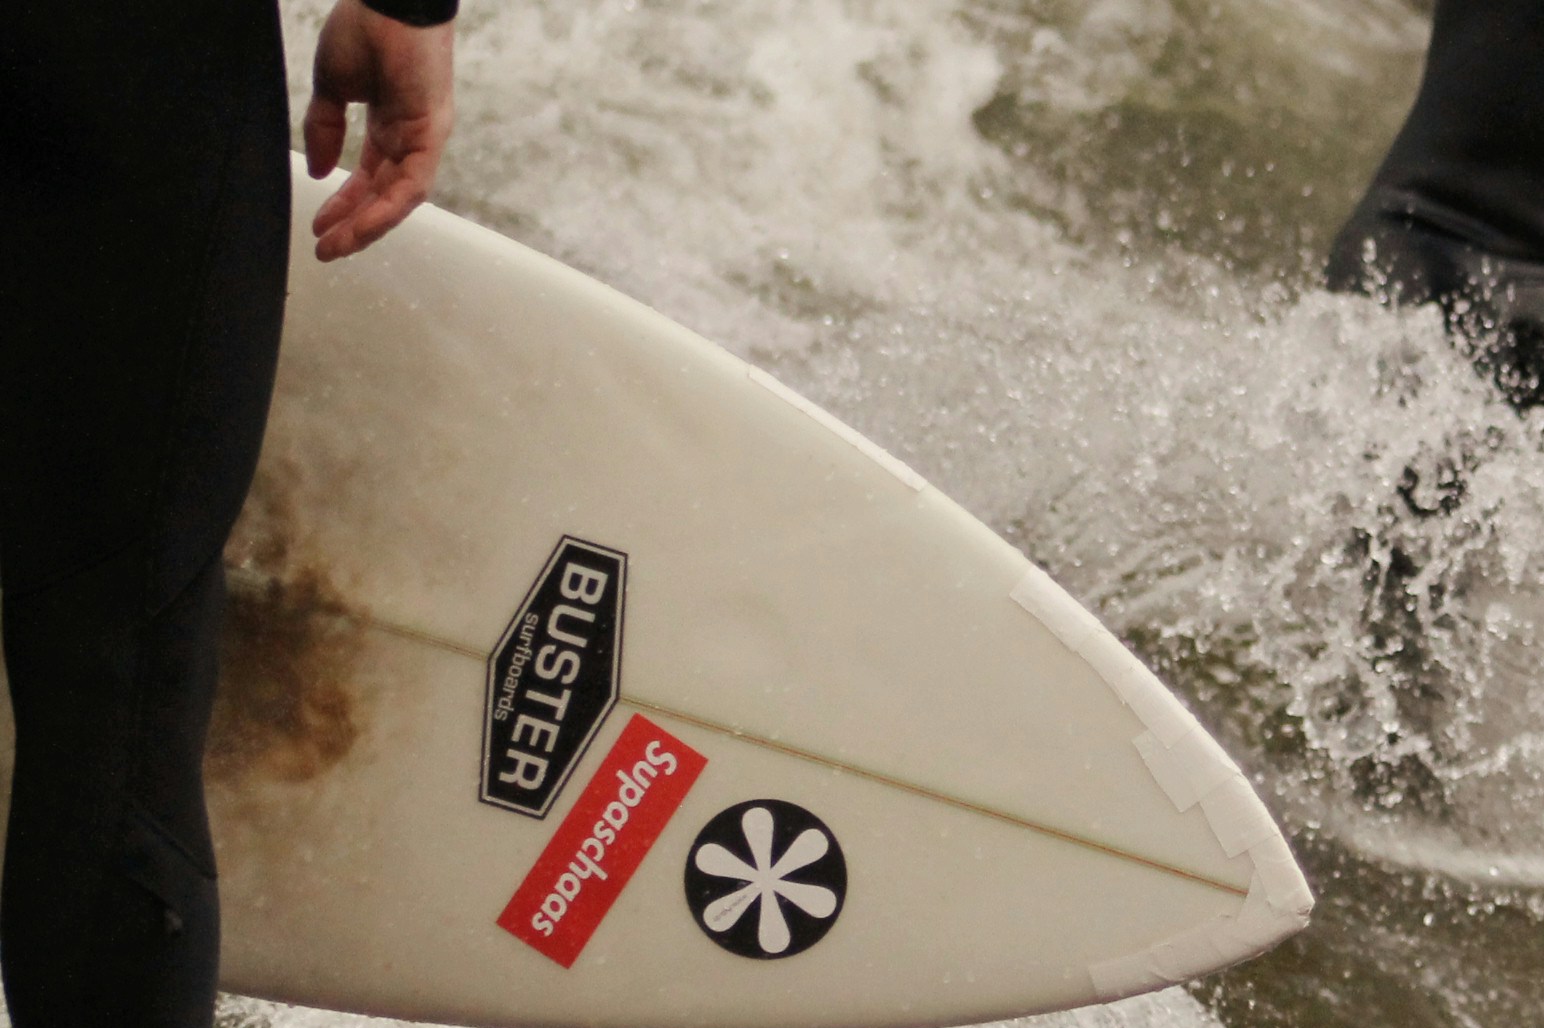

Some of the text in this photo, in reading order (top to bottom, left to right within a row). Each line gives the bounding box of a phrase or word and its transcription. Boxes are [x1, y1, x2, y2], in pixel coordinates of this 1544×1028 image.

[494, 613, 538, 721] surfboards
[499, 562, 608, 791] BUSTER
[531, 740, 677, 935] Supaschaas
